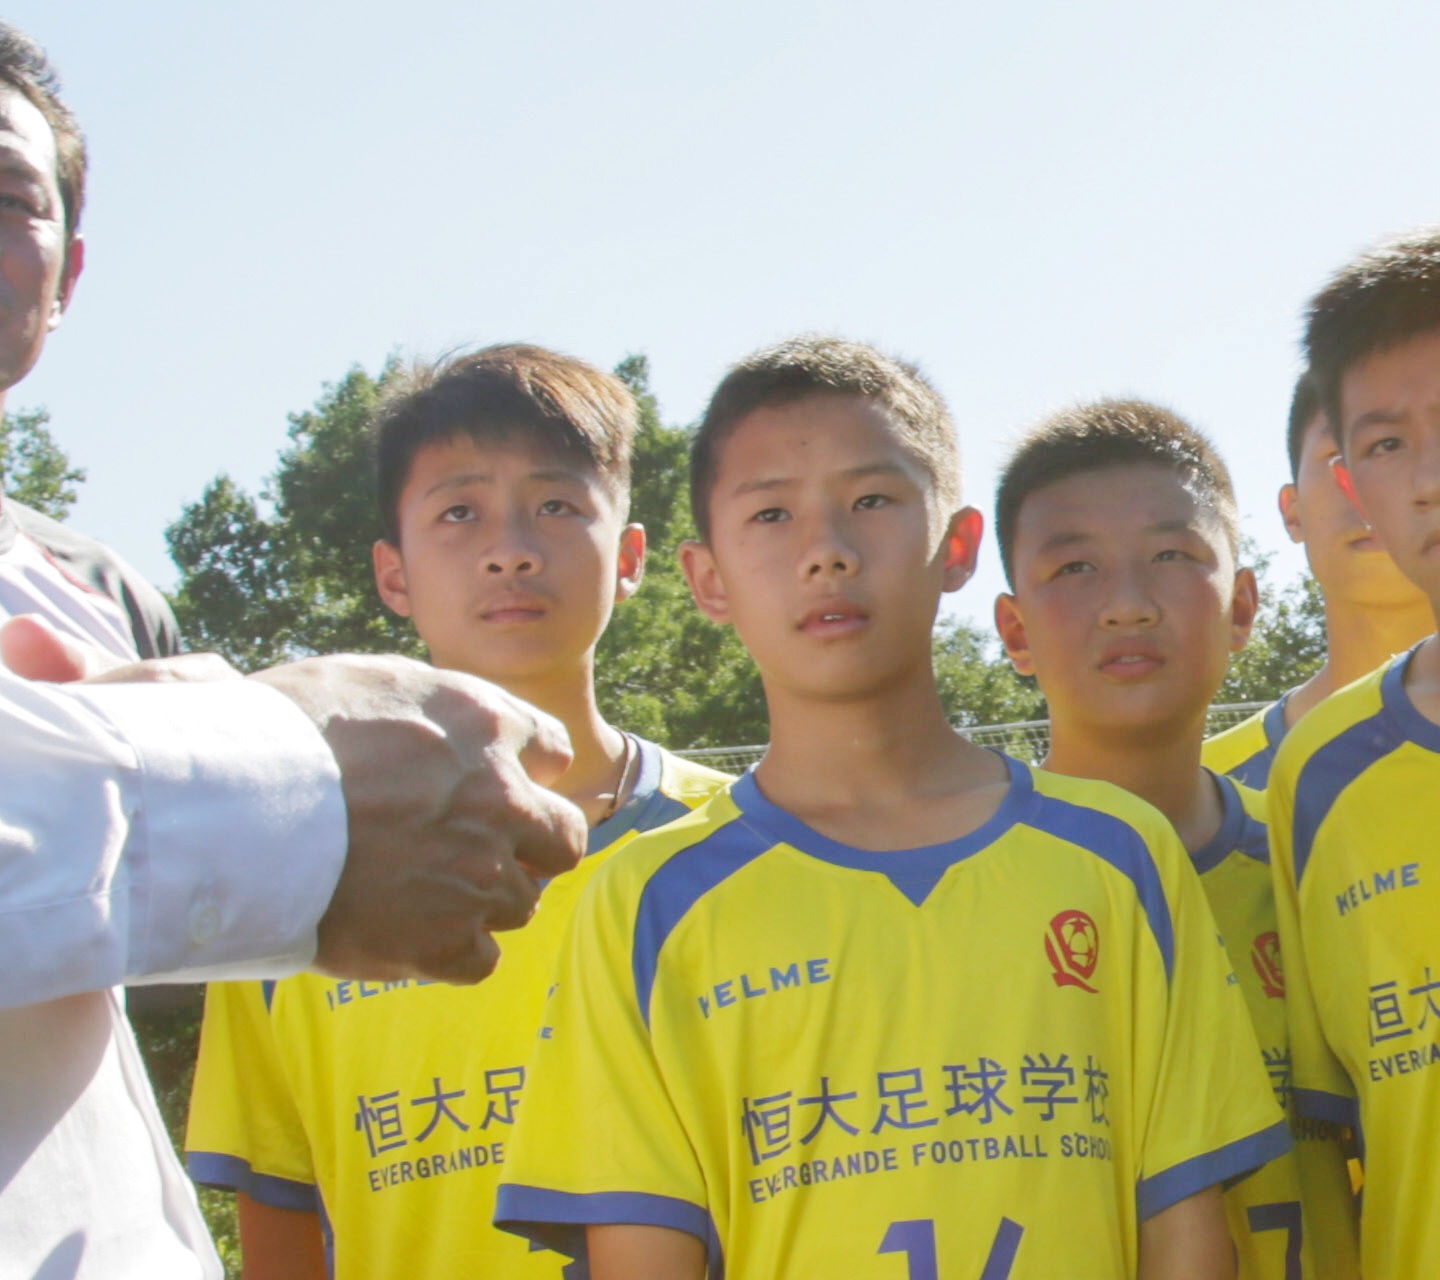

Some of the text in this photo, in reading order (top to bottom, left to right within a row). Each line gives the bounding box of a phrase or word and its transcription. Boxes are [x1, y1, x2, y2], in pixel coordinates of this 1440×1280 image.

[1336, 862, 1420, 917] KELME
[355, 1066, 526, 1158] 恒大足
[741, 1053, 1111, 1166] 恒大足球学校
[912, 1134, 1048, 1166] FOOTBALL
